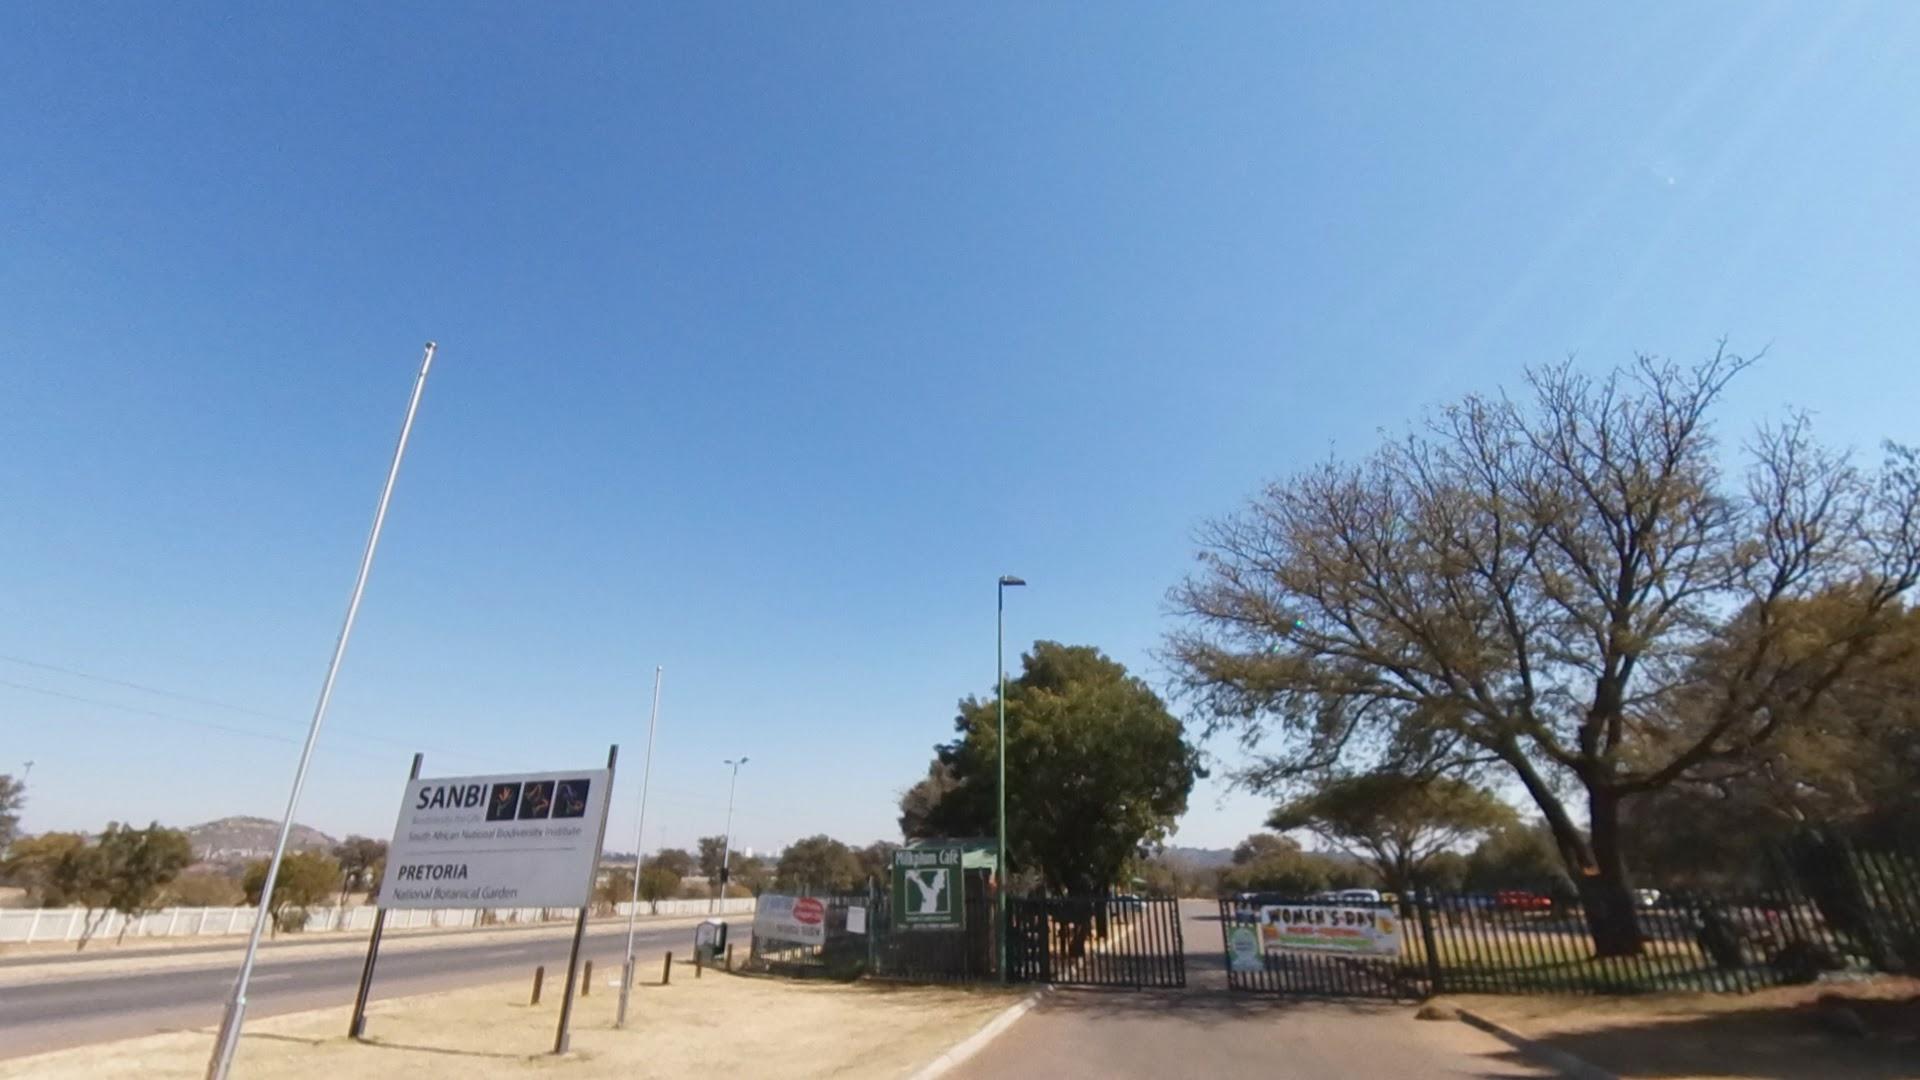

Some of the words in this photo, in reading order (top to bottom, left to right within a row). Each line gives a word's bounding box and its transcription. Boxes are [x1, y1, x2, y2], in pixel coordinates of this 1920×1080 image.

[416, 784, 488, 810] SANBI
[409, 831, 432, 842] South
[432, 829, 460, 843] African
[462, 828, 495, 841] National
[496, 827, 543, 841] Biodiversity
[544, 826, 582, 837] Institute
[398, 864, 468, 881] PRETORIA
[393, 887, 433, 902] National
[434, 887, 481, 900] Botanical
[481, 887, 518, 899] Garden
